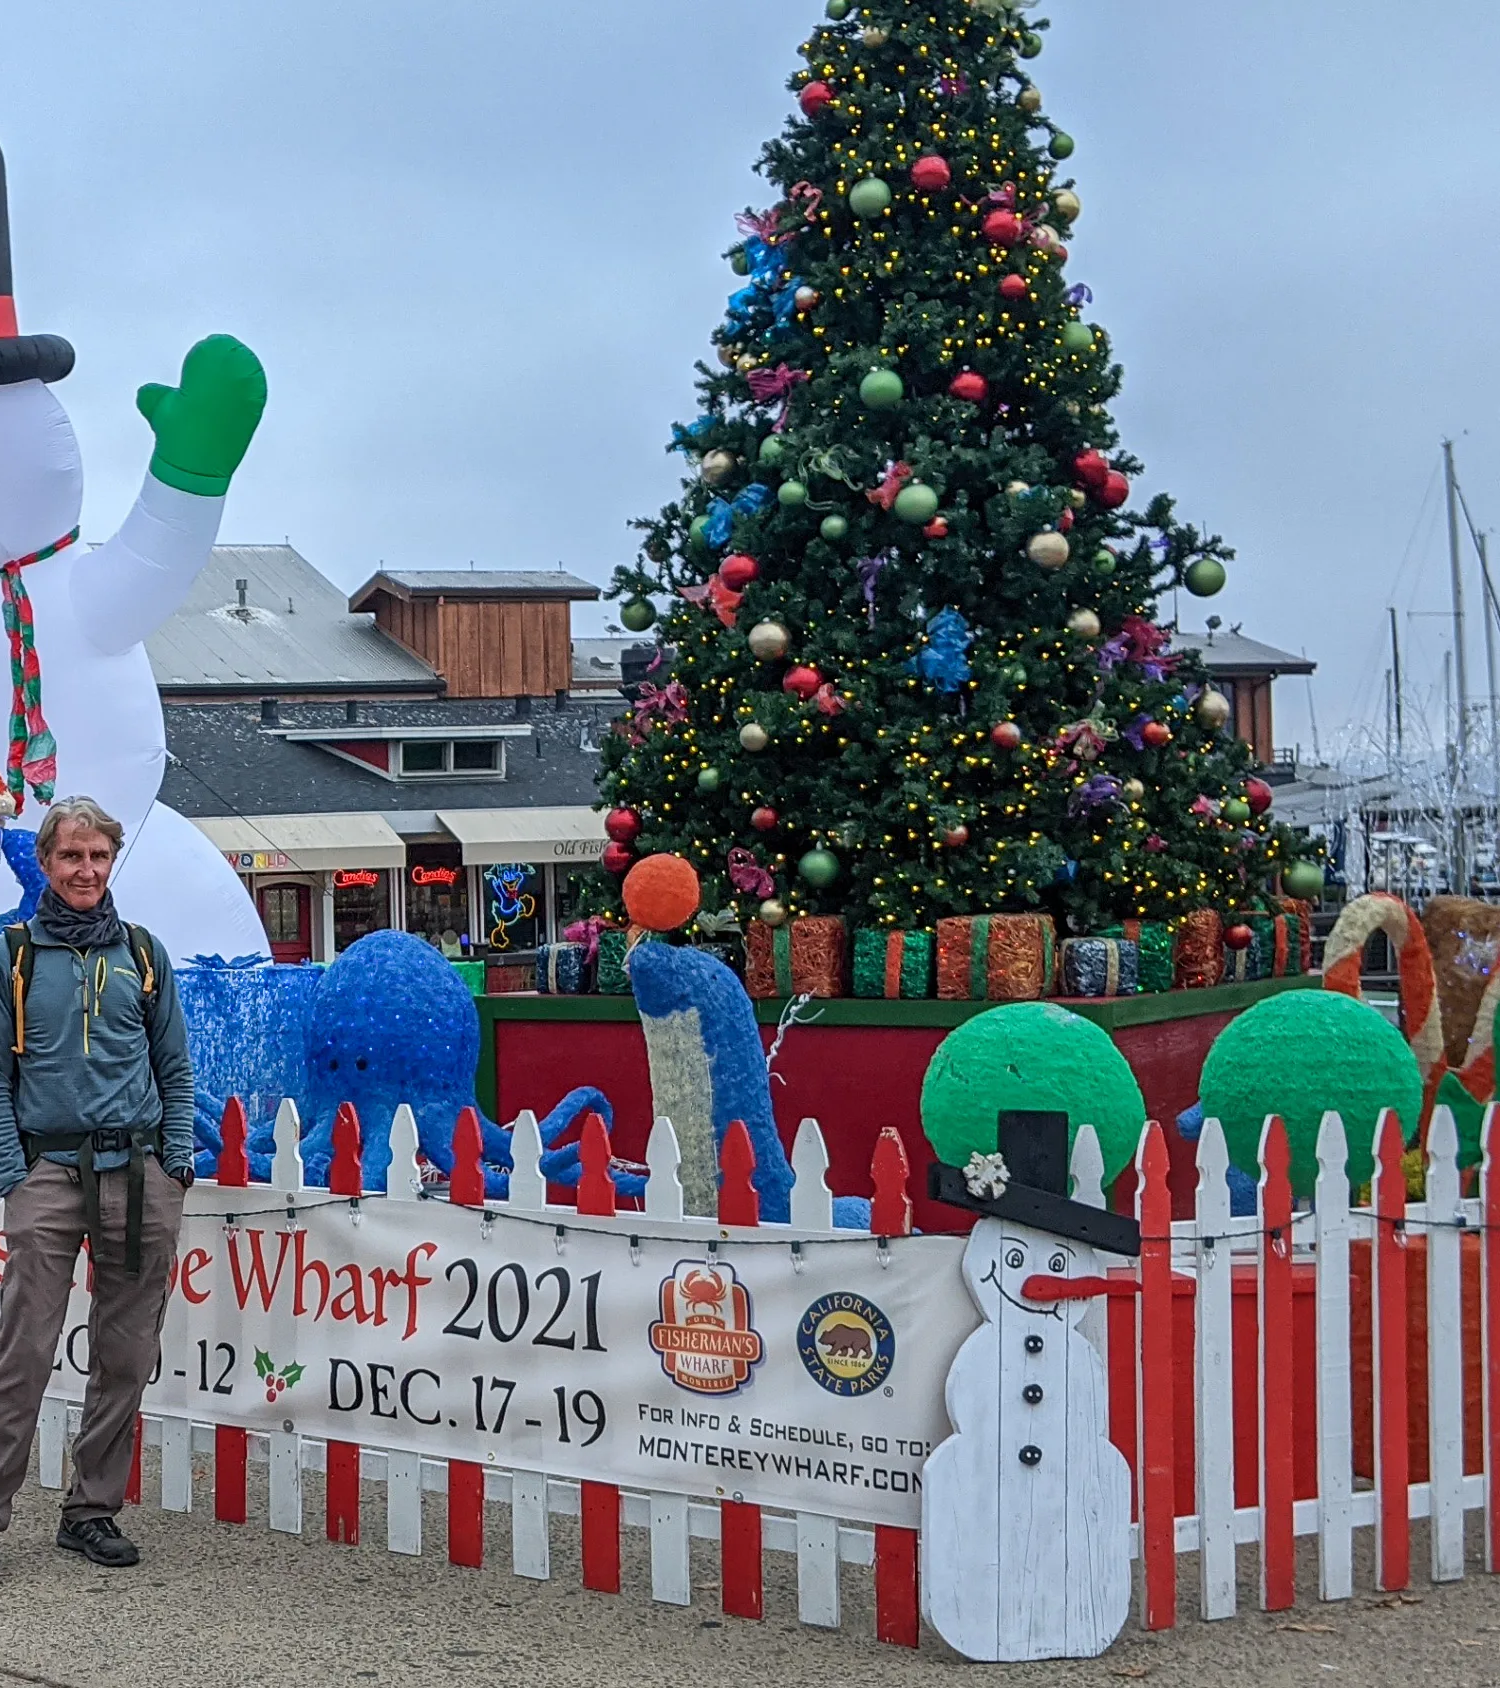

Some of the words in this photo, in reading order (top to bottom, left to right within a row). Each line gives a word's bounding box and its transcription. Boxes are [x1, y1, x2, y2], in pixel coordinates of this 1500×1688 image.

[554, 840, 578, 856] Old
[225, 851, 287, 870] WORLD
[333, 868, 379, 887] Candies
[412, 866, 456, 886] Candies
[222, 1227, 438, 1341] Wharf
[442, 1258, 608, 1352] 2021
[693, 1315, 717, 1325] OLD
[802, 1295, 889, 1342] CALIFORNIA
[658, 1328, 754, 1356] FISHERMAN'S
[680, 1354, 730, 1375] WHARF
[801, 1347, 844, 1393] STATE
[850, 1354, 890, 1394] PARKS
[827, 1358, 848, 1367] SINCE
[681, 1374, 730, 1388] MONTEREY
[328, 1357, 458, 1428] DEC.
[728, 1415, 741, 1435] &
[861, 1436, 888, 1453] GO
[896, 1439, 931, 1457] TO:
